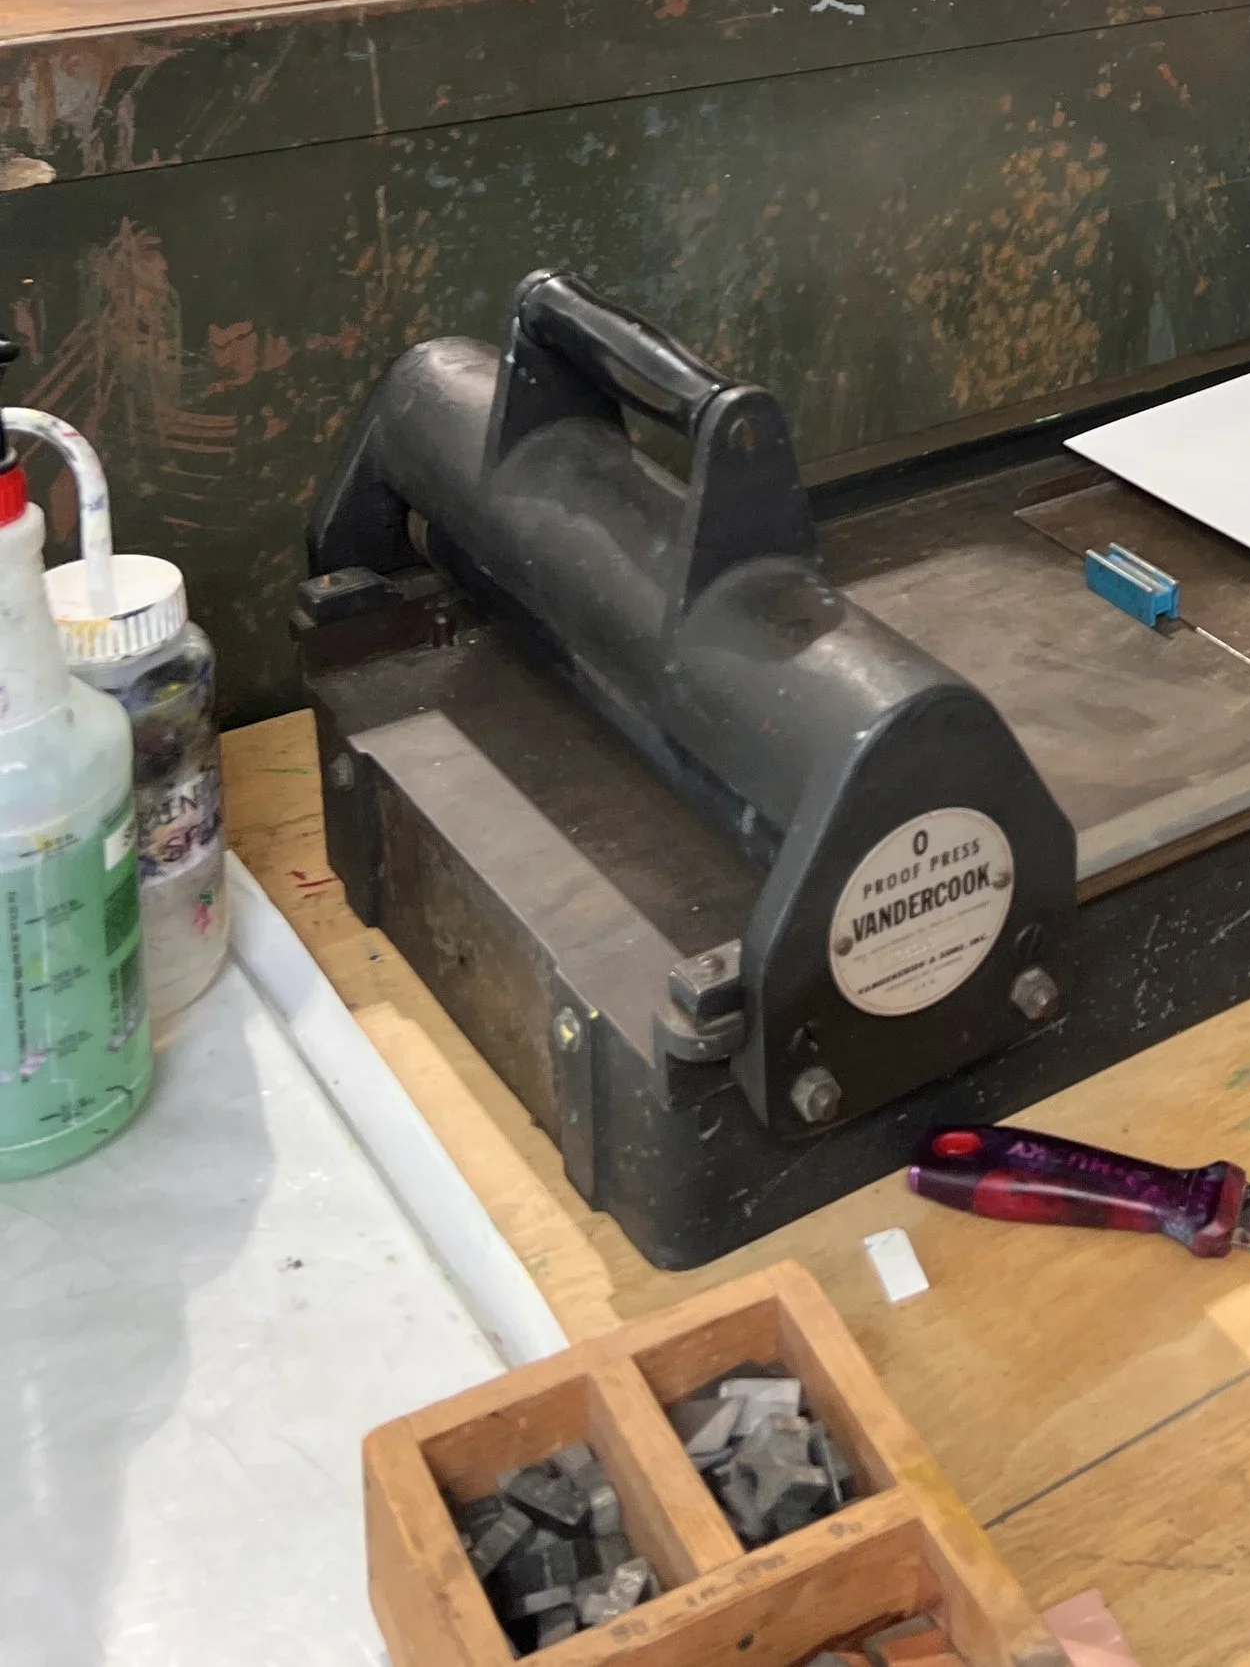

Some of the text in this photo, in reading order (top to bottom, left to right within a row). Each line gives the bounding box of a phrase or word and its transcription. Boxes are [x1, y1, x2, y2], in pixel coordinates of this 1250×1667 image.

[852, 862, 990, 942] VANDERCOOK
[863, 838, 981, 901] PROOF PRESS
